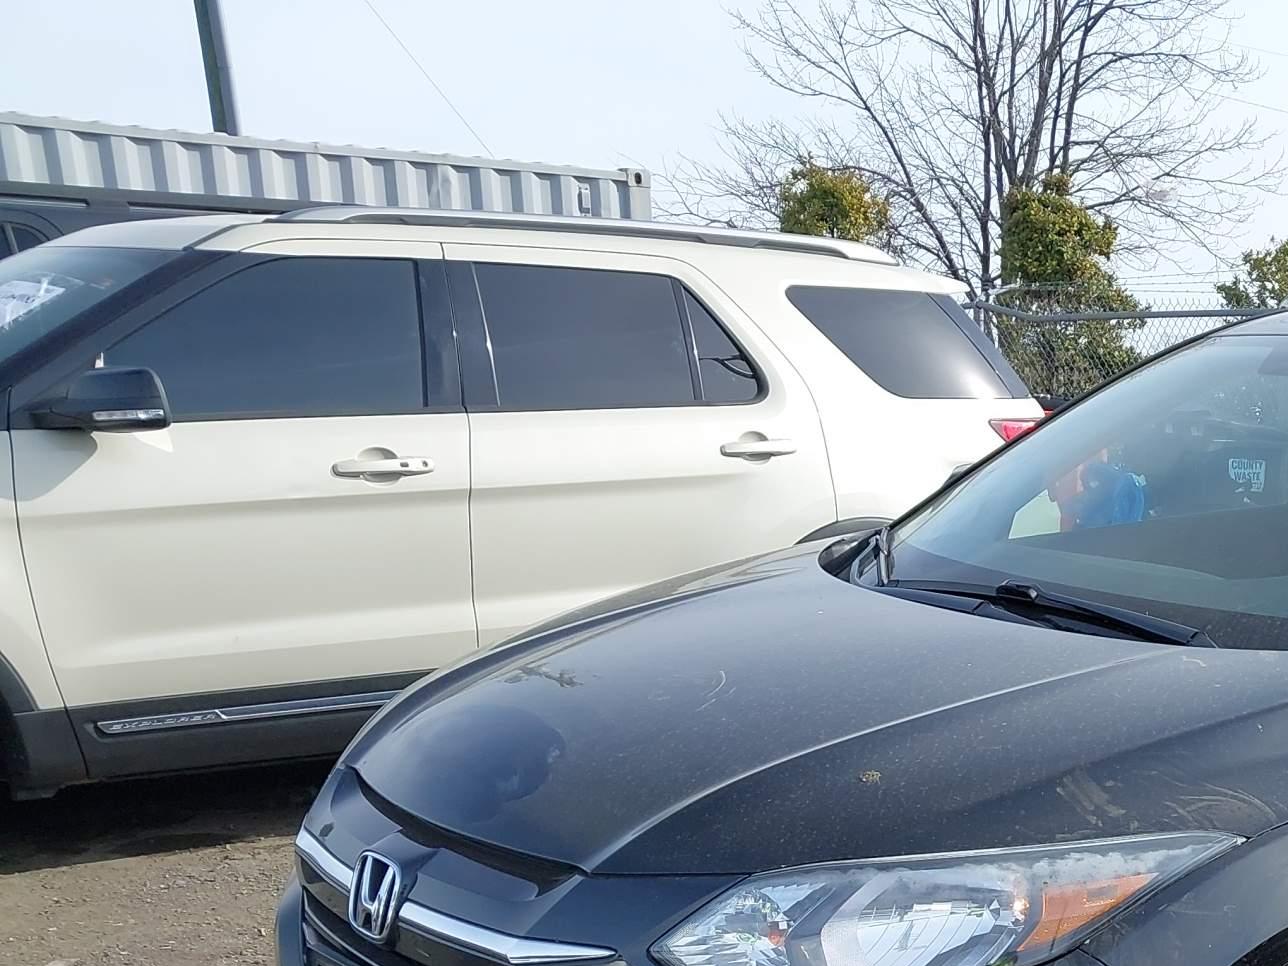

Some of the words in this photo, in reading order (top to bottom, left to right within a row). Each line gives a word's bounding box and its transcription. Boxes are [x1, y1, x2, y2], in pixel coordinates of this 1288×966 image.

[1231, 459, 1264, 471] COUNTY
[1233, 471, 1262, 482] WASTE
[109, 713, 217, 732] EXPLORER
